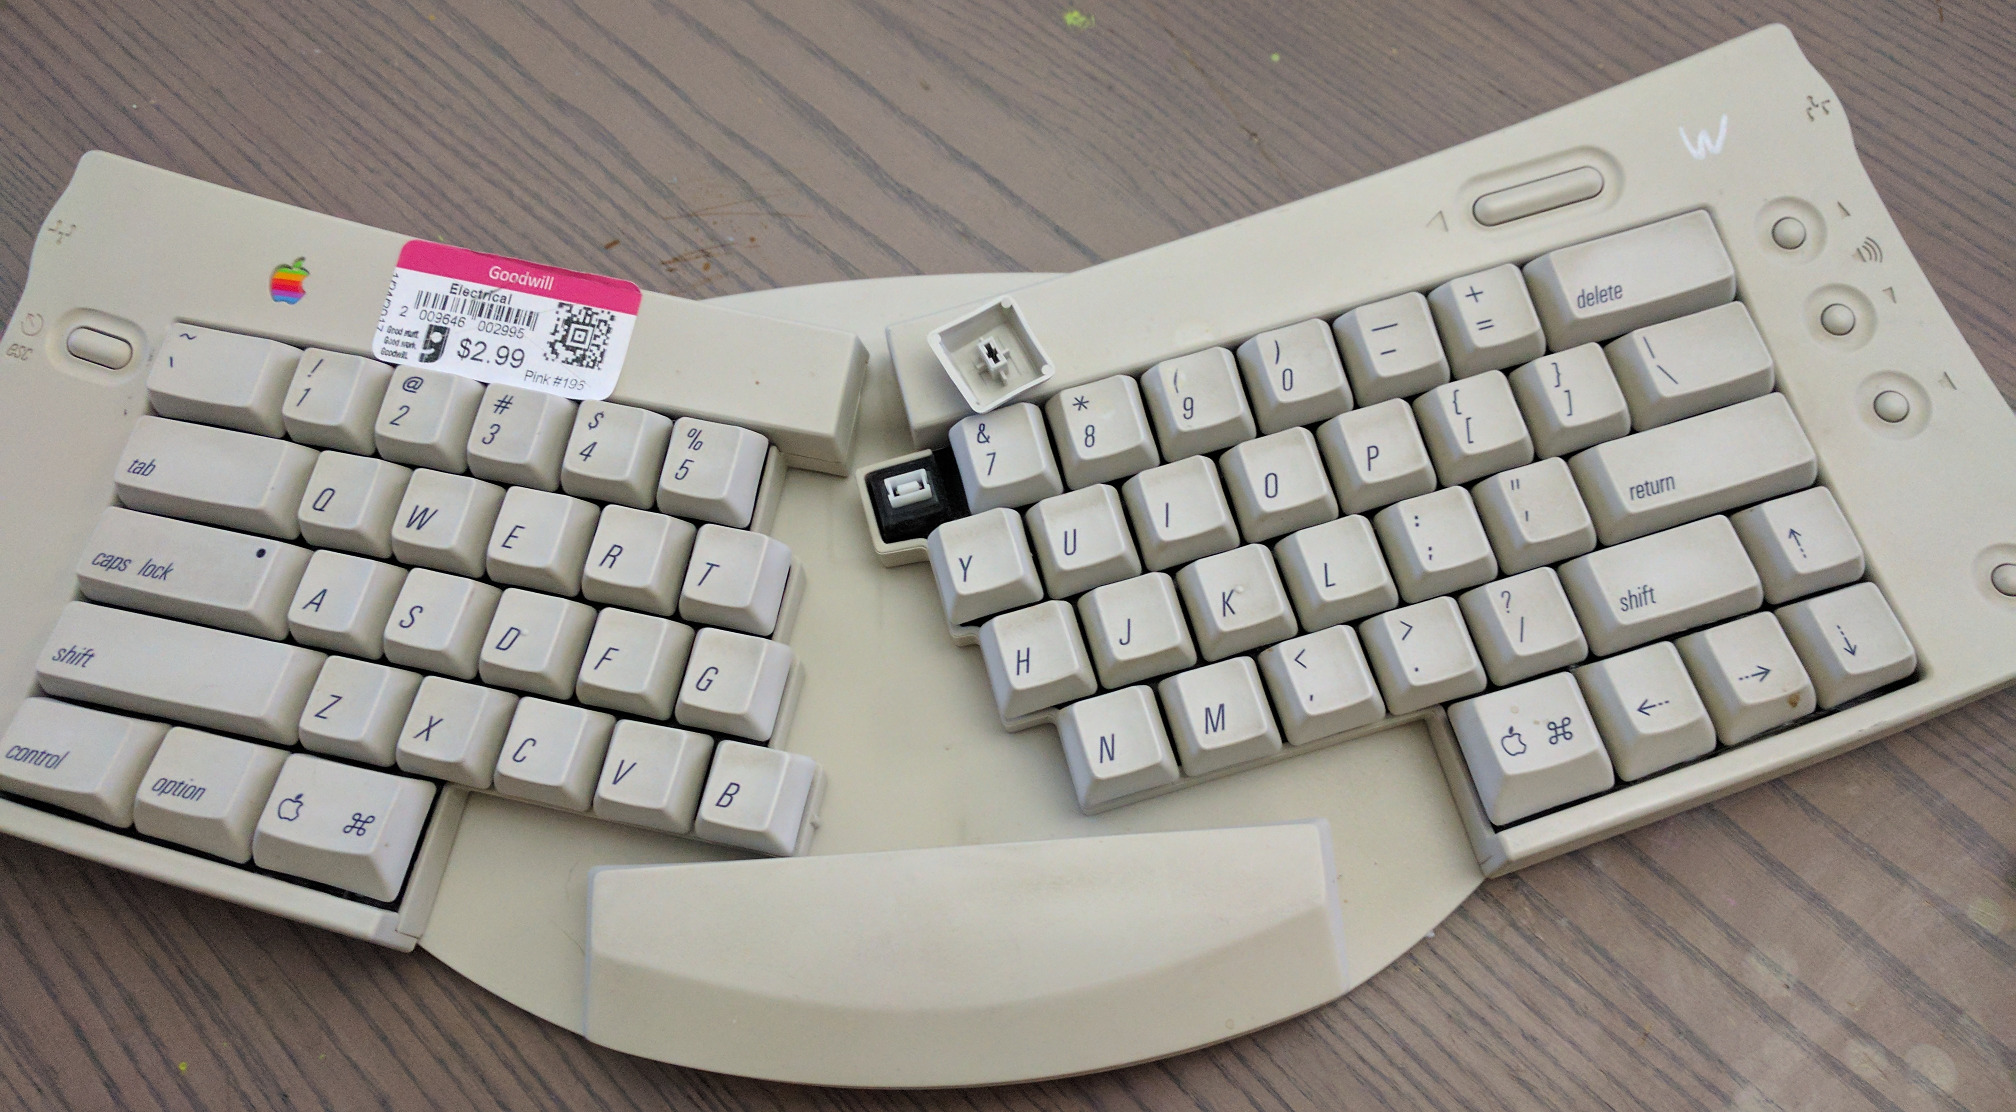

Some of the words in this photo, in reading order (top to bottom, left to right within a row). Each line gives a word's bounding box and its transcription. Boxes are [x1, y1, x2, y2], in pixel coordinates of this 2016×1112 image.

[488, 265, 555, 292] Goodwill
[449, 282, 513, 306] Electrical
[1465, 285, 1484, 303] +
[1576, 284, 1624, 310] delete
[398, 304, 409, 318] 2
[418, 308, 467, 329] 009646
[477, 319, 526, 340] 002995
[1476, 318, 1495, 331] =
[6, 342, 34, 361] esc
[456, 337, 526, 369] $2.99
[307, 358, 324, 378] !
[523, 369, 551, 386] Pink
[552, 375, 586, 391] #195
[1551, 361, 1561, 388] }
[402, 376, 424, 394] @
[1172, 368, 1180, 394] (
[295, 387, 312, 407] 1
[493, 394, 514, 415] #
[1182, 396, 1194, 420] 9
[1452, 389, 1463, 416] {
[1563, 389, 1573, 417] ]
[388, 404, 411, 427] 2
[587, 411, 605, 430] $
[481, 423, 501, 445] 3
[687, 427, 704, 451] %
[976, 422, 991, 444] &
[1084, 424, 1096, 448] 8
[1465, 416, 1474, 445] [
[578, 441, 598, 462] 4
[986, 451, 998, 476] 7
[1366, 445, 1380, 472] P
[126, 458, 156, 477] tab
[674, 458, 695, 481] 5
[311, 487, 336, 512] Q
[1629, 475, 1677, 501] return
[405, 504, 439, 531] W
[501, 524, 526, 549] E
[1063, 528, 1077, 556] U
[91, 552, 133, 572] caps
[137, 558, 174, 581] lock
[598, 544, 624, 569] R
[958, 554, 973, 583] Y
[697, 562, 721, 587] T
[1323, 562, 1336, 588] L
[302, 588, 328, 613] A
[1222, 589, 1236, 618] K
[1500, 590, 1513, 614] ?
[1619, 584, 1657, 612] shift
[398, 605, 424, 629] S
[495, 626, 522, 652] D
[1118, 618, 1131, 646] J
[1399, 620, 1413, 641] >
[51, 644, 95, 668] shift
[593, 646, 620, 671] F
[1016, 647, 1030, 676] H
[1294, 648, 1307, 669] <
[695, 666, 719, 692] G
[314, 694, 343, 720] Z
[1204, 703, 1225, 735] M
[413, 715, 444, 742] X
[4, 745, 70, 770] control
[511, 737, 537, 763] C
[1099, 733, 1115, 764] N
[611, 759, 638, 786] V
[151, 776, 206, 802] option
[715, 781, 741, 808] B
